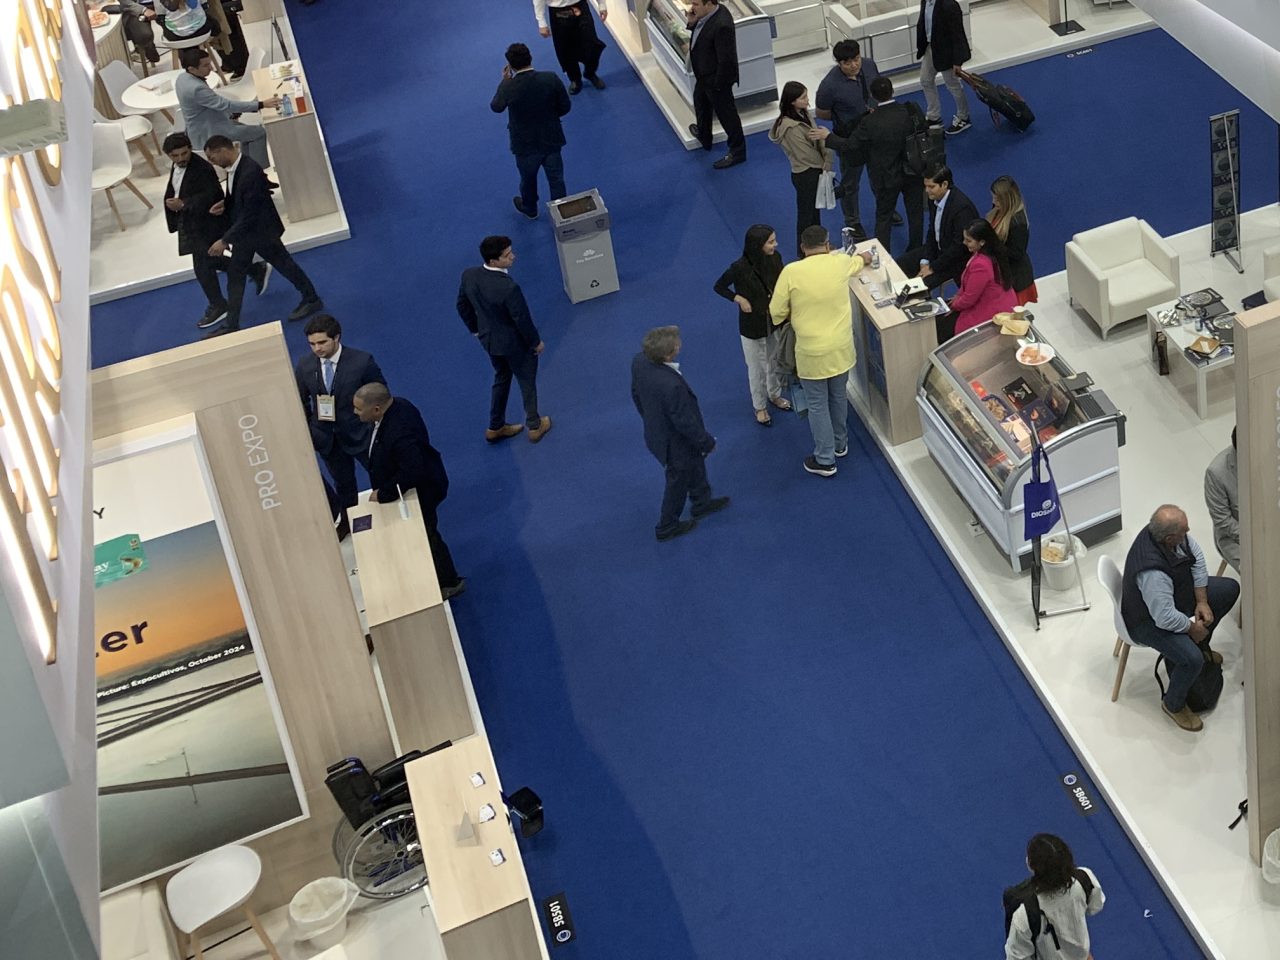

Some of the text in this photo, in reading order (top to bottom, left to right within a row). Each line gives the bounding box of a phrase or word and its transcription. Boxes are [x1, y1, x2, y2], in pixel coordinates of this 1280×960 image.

[238, 414, 282, 510] PRO EXPO
[96, 643, 245, 698] Picture: Expocultivos, October 2024
[1072, 786, 1092, 810] 5B601
[549, 900, 565, 928] 5B501
